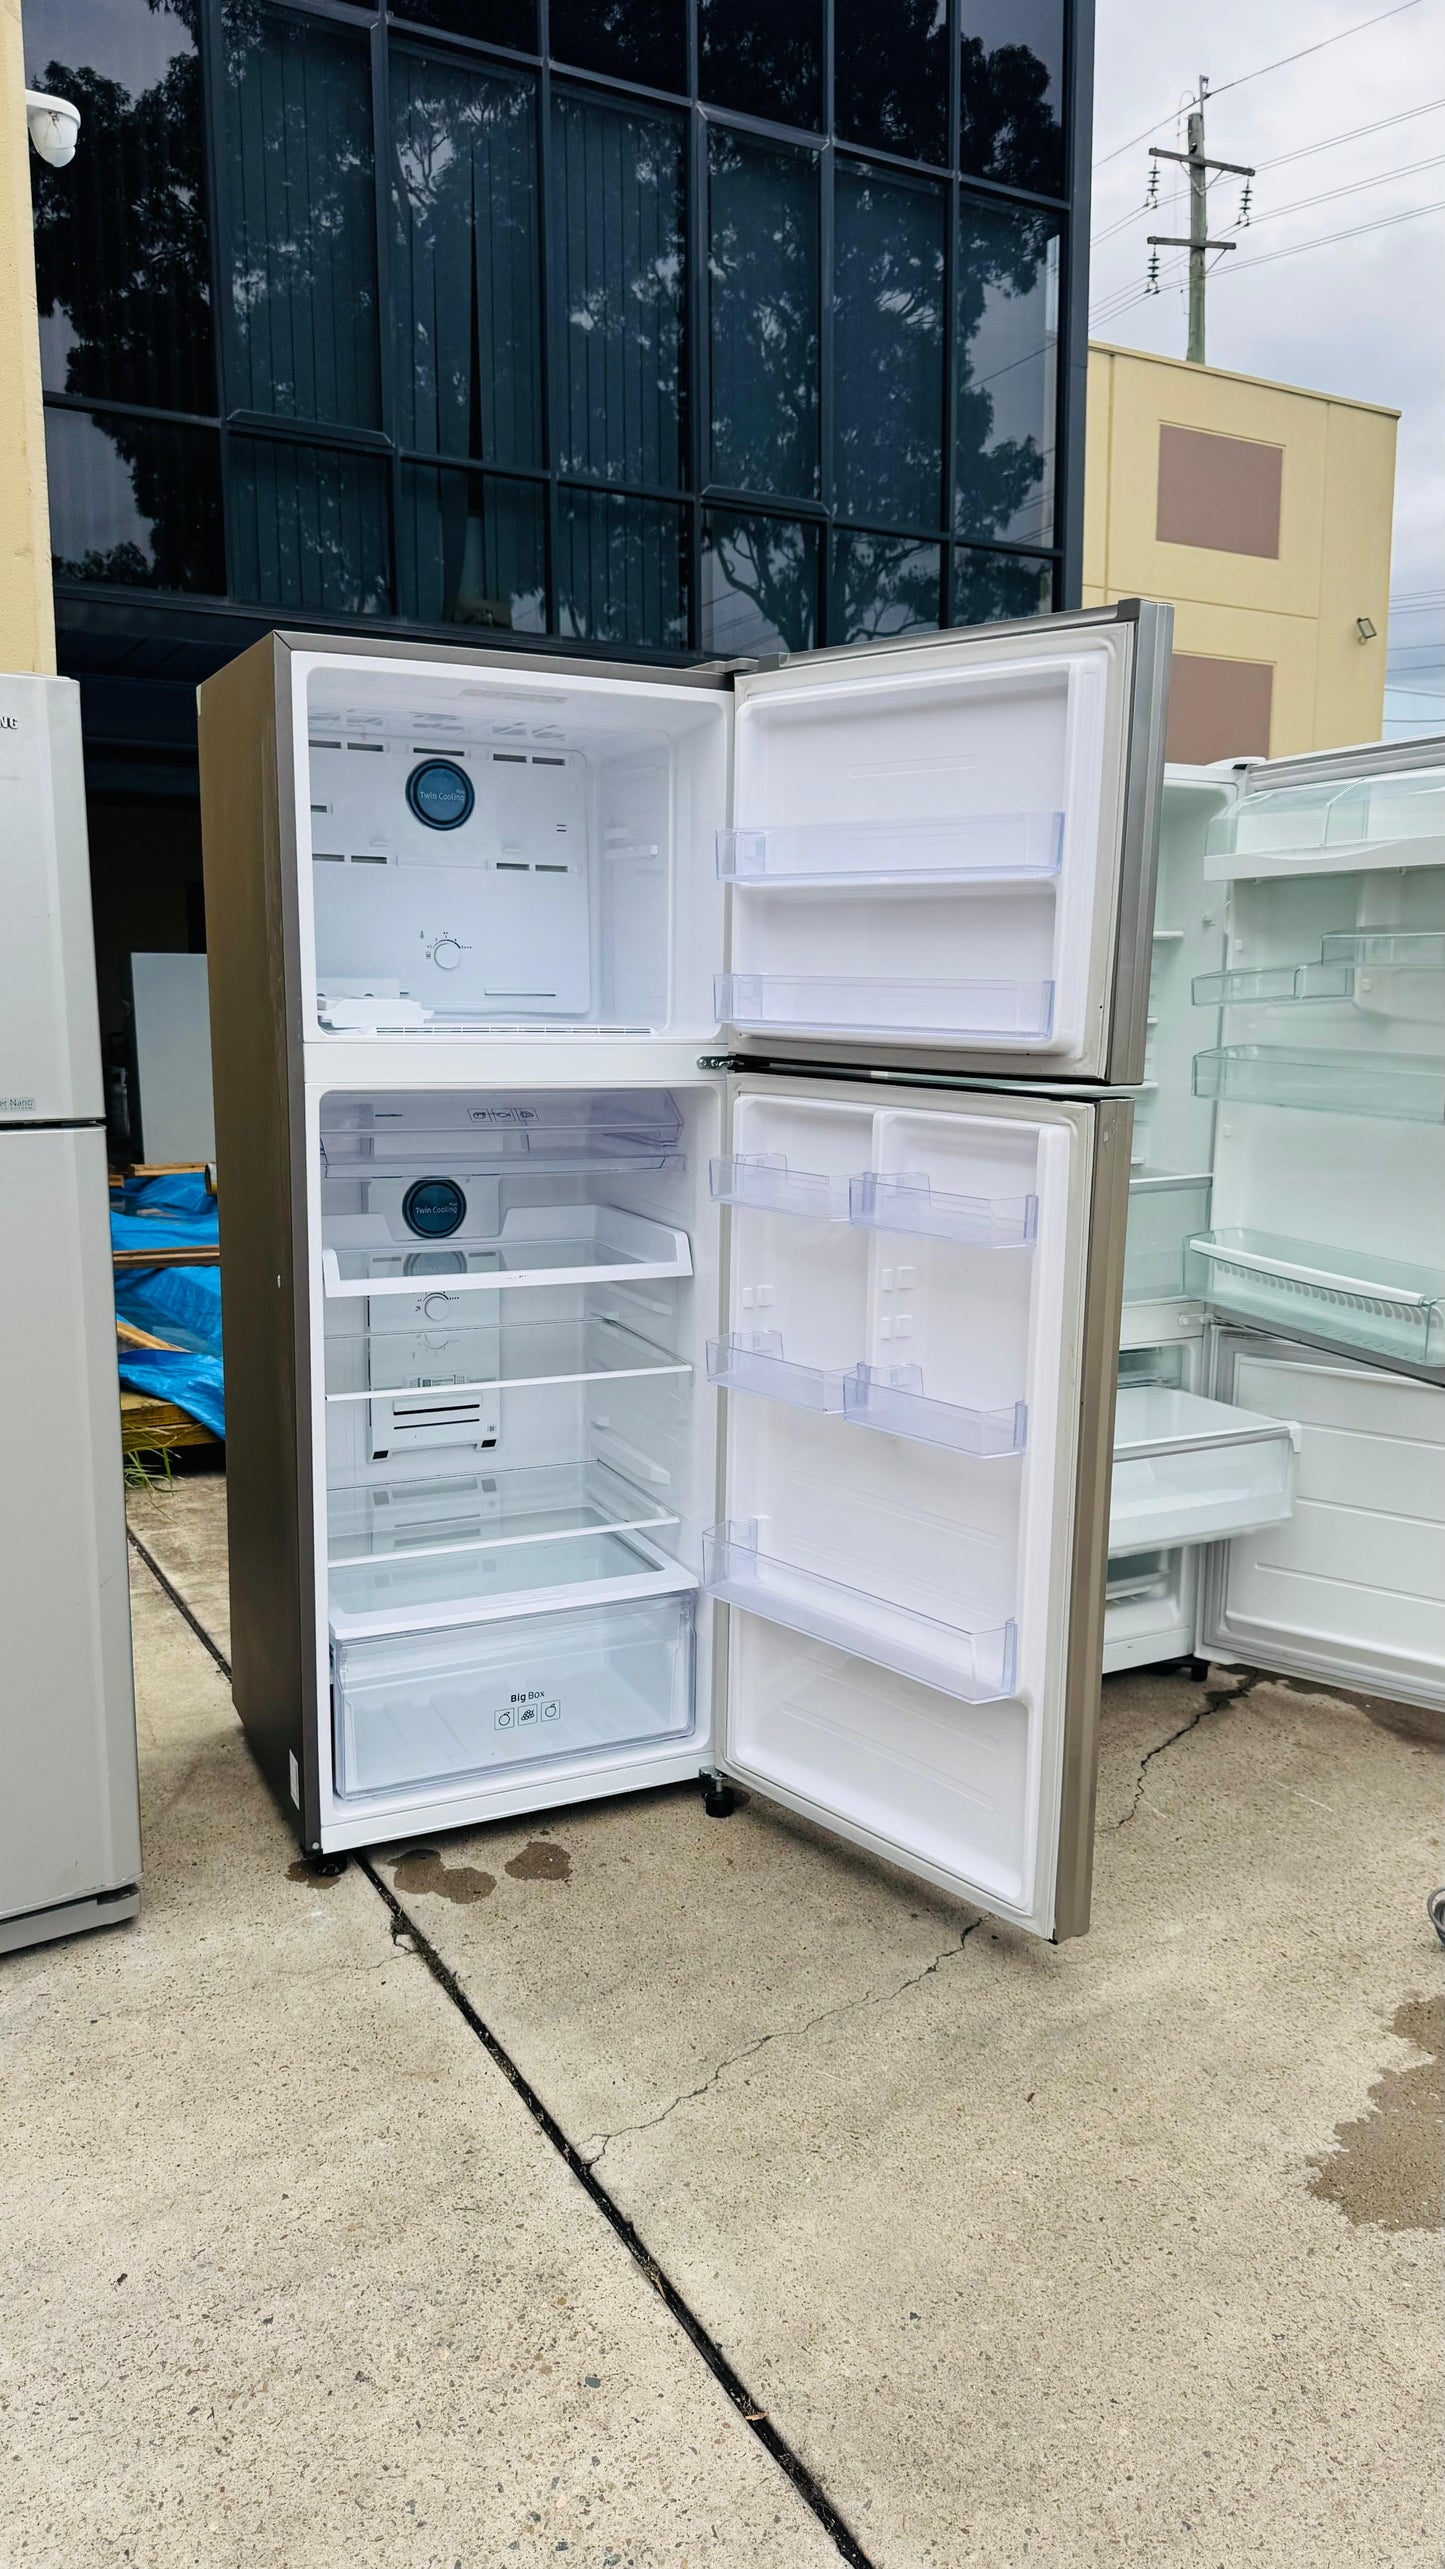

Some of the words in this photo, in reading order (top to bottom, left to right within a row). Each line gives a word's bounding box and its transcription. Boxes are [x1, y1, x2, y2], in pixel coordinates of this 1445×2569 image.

[420, 791, 438, 800] Twin
[438, 792, 465, 804] Cooling
[9, 1099, 33, 1107] Nano
[415, 1206, 432, 1214] Twin
[432, 1205, 458, 1214] Cooling
[510, 1693, 526, 1703] Big
[528, 1691, 545, 1700] Box
